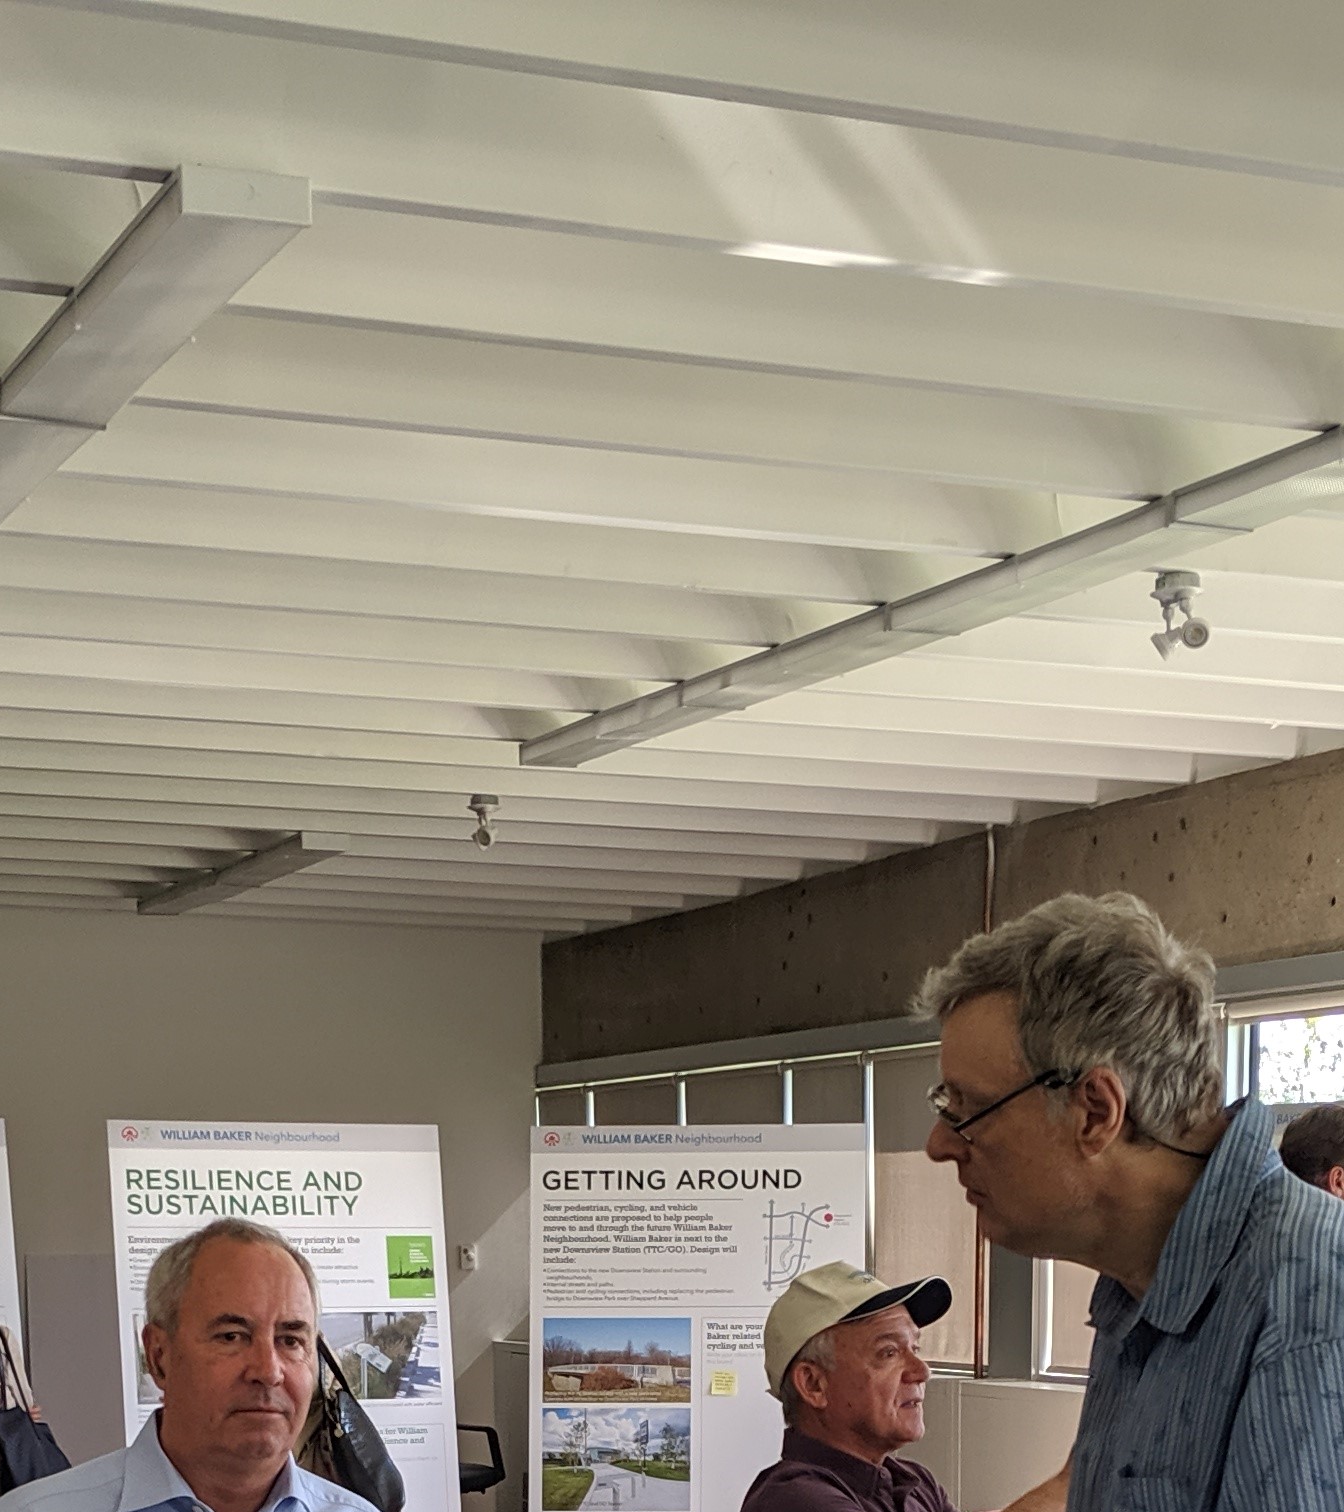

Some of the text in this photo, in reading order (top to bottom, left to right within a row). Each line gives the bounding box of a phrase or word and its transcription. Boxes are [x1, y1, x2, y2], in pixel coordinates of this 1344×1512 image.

[161, 1130, 340, 1144] WILLIAM BAKER Neighbourhood
[582, 1133, 762, 1147] WILLIAM BAKER Neighbourhood
[126, 1169, 362, 1191] RESILIENCE AND
[542, 1169, 802, 1190] GETTING AROUND
[127, 1194, 358, 1216] SUSTAINABILITY
[564, 1204, 612, 1213] pedestrian,
[614, 1204, 647, 1213] cycling,
[649, 1204, 665, 1212] and
[667, 1204, 698, 1212] vehicle
[543, 1214, 593, 1222] connections
[611, 1214, 651, 1223] proposed
[663, 1214, 682, 1223] help
[684, 1214, 713, 1223] people
[596, 1224, 629, 1233] through
[305, 1237, 335, 1245] priority
[543, 1235, 612, 1244] Neighbourhood.
[690, 1246, 720, 1255] Design
[543, 1256, 576, 1264] include:
[745, 1324, 763, 1332] your
[732, 1332, 761, 1340] related
[707, 1342, 737, 1351] cycling
